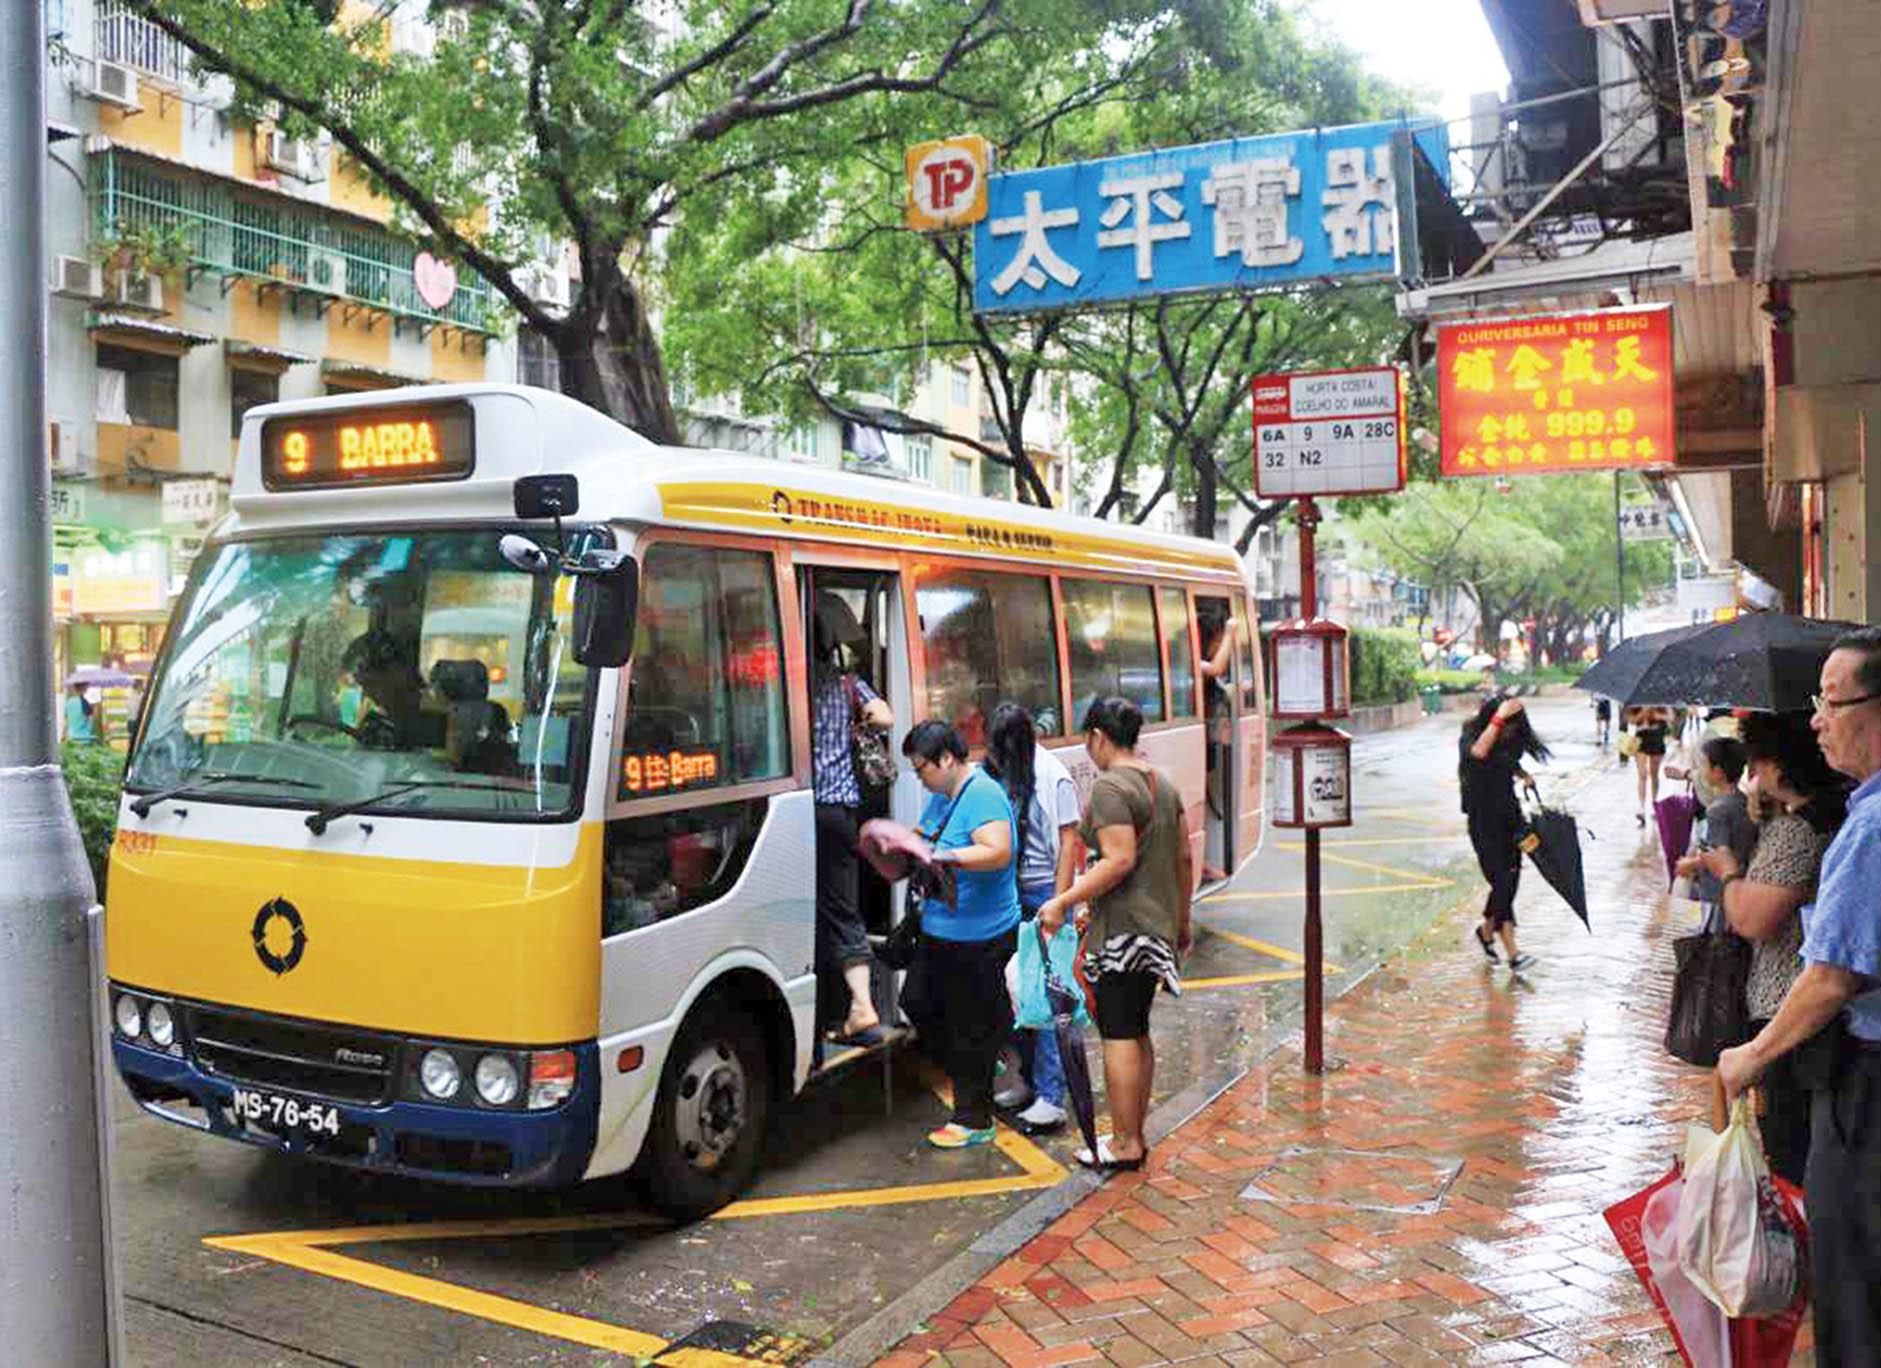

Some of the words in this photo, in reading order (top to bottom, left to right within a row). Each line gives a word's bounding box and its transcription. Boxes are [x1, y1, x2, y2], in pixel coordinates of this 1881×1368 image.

[924, 159, 974, 209] TP
[989, 144, 1397, 296] 太平電器
[1573, 321, 1599, 335] TIN
[1606, 316, 1649, 333] SENG
[1353, 395, 1390, 408] AMARAL
[1262, 429, 1286, 443] 6A
[1303, 426, 1313, 441] 9
[1332, 425, 1355, 440] 9A
[1365, 422, 1395, 438] 28C
[1546, 407, 1636, 438] 999.9
[285, 432, 307, 473] 9
[340, 421, 437, 469] BARRA
[1265, 453, 1284, 468] 32
[1300, 450, 1322, 465] N2
[625, 756, 641, 790] 9
[233, 1088, 340, 1135] MS-76-54
